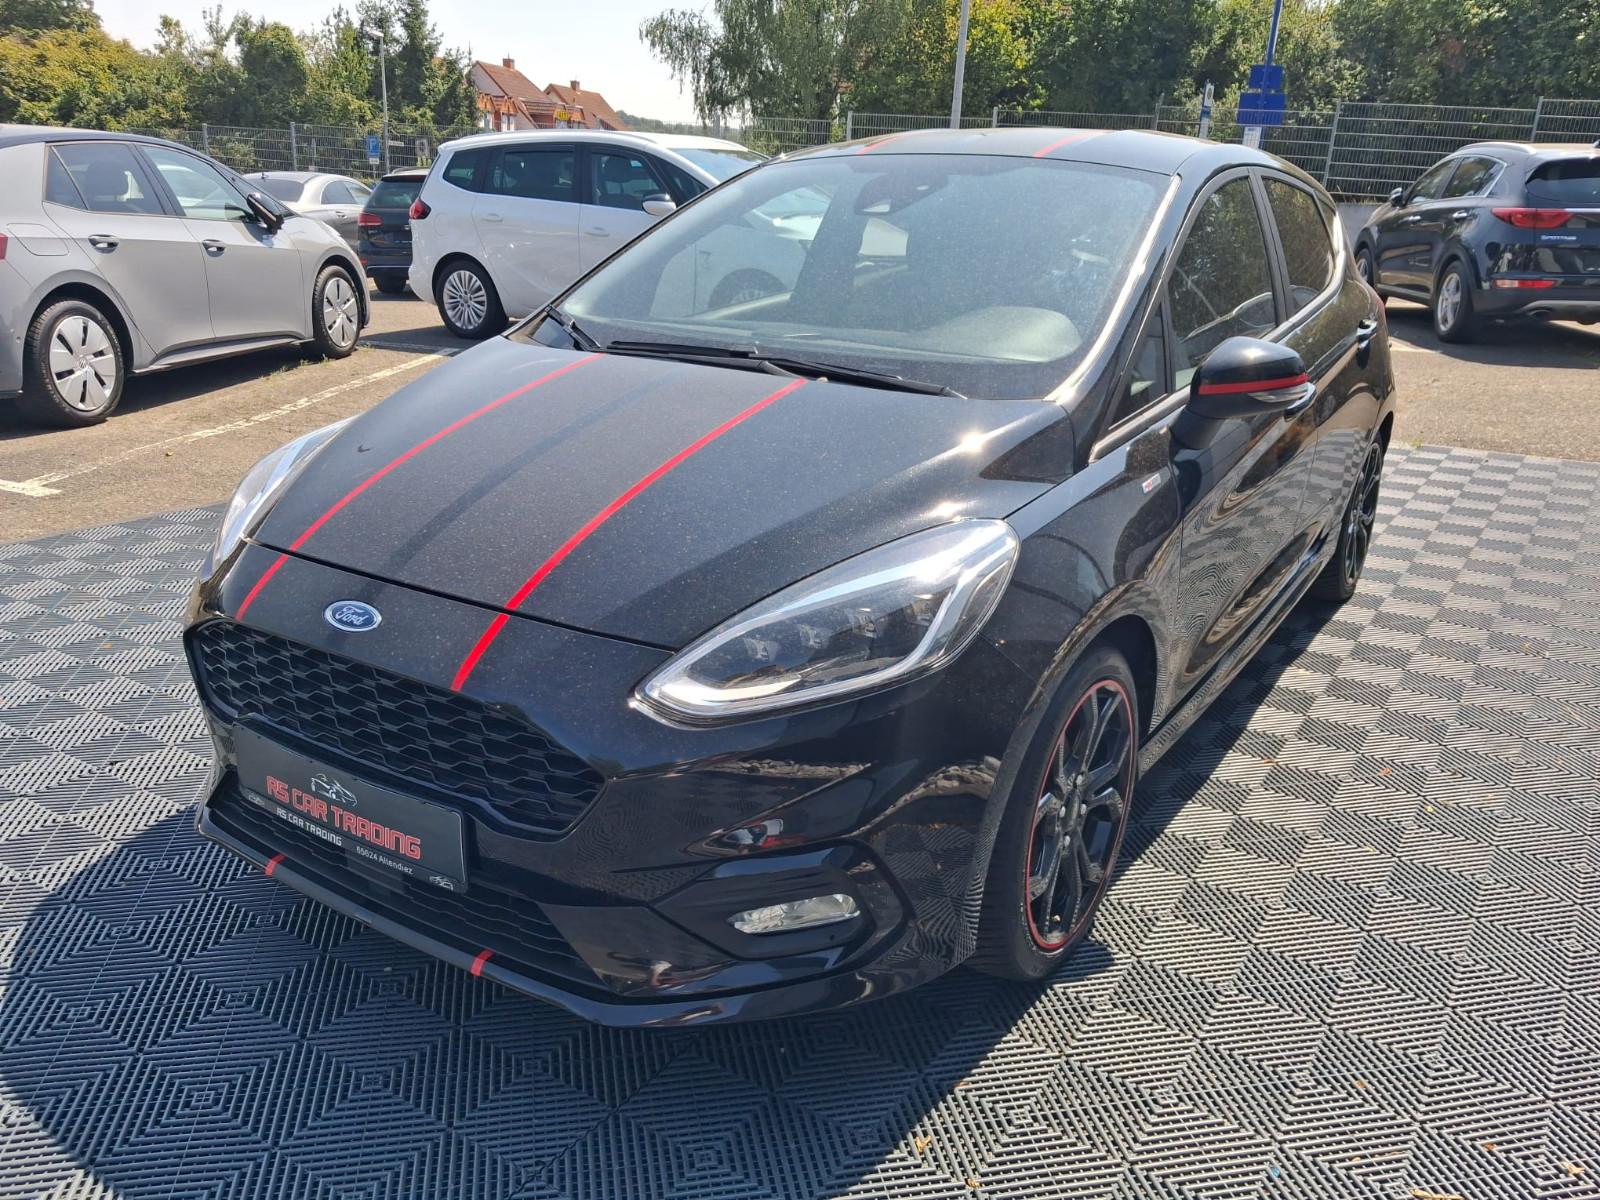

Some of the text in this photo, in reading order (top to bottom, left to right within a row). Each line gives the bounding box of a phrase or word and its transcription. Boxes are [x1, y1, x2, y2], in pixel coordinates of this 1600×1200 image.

[335, 605, 369, 626] Ford
[266, 775, 421, 860] RS CAR TRADING
[276, 807, 343, 847] RS CAR TRADING
